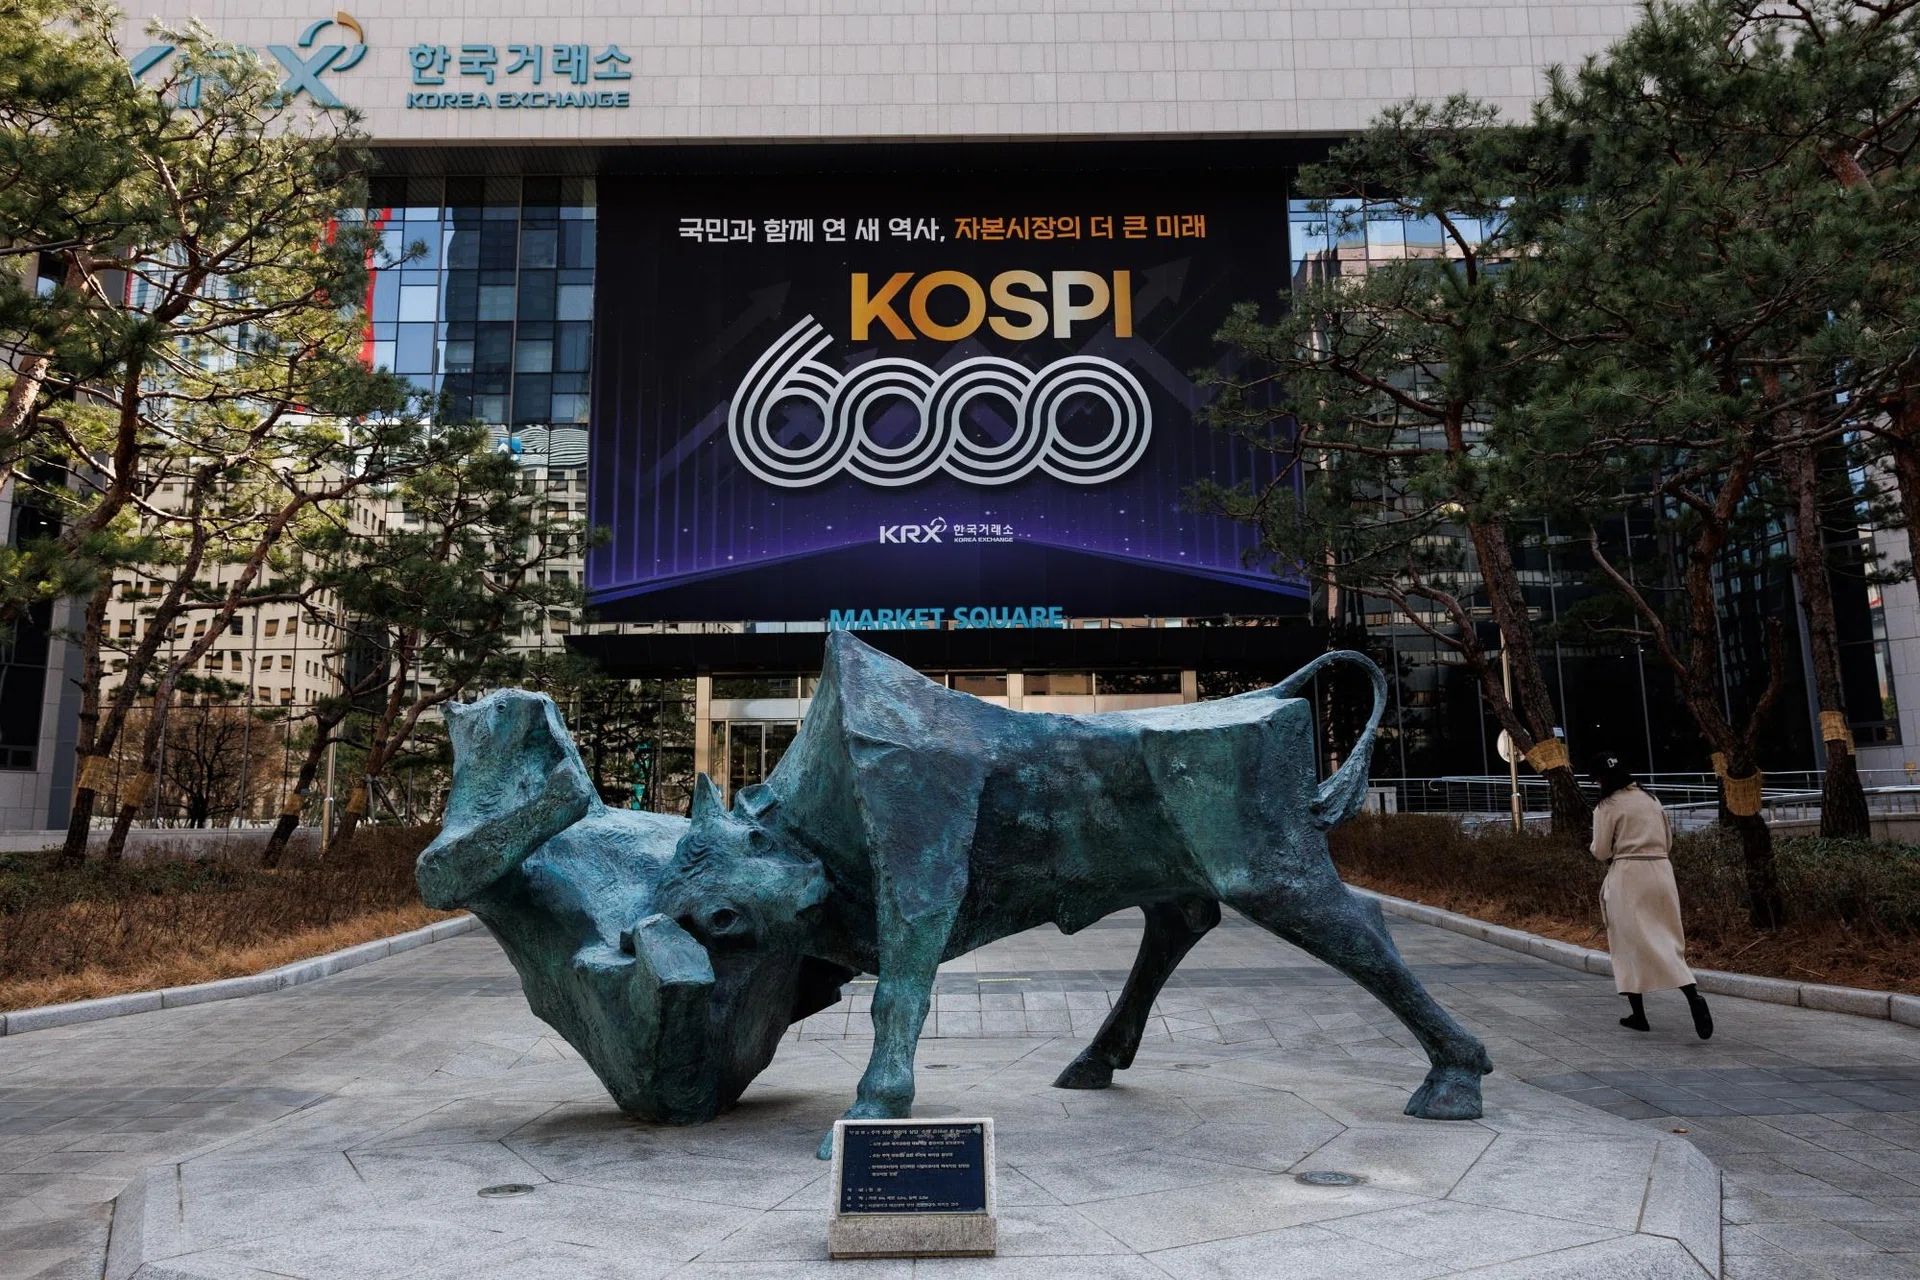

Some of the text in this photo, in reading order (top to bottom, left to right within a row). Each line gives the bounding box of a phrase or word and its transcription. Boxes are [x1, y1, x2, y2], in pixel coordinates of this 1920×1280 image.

[409, 43, 632, 85] 한국거래소
[406, 91, 630, 109] KOREA EXCHANGE
[678, 214, 1206, 243] 국민과 함께 연 새 역사, 자본시장의 더 큰 미래
[851, 269, 1133, 342] KOSPI
[727, 313, 1153, 488] 6000
[879, 524, 943, 544] KRX
[953, 523, 1014, 536] 한국거래소
[829, 606, 1064, 631] MARKET SQUARE
